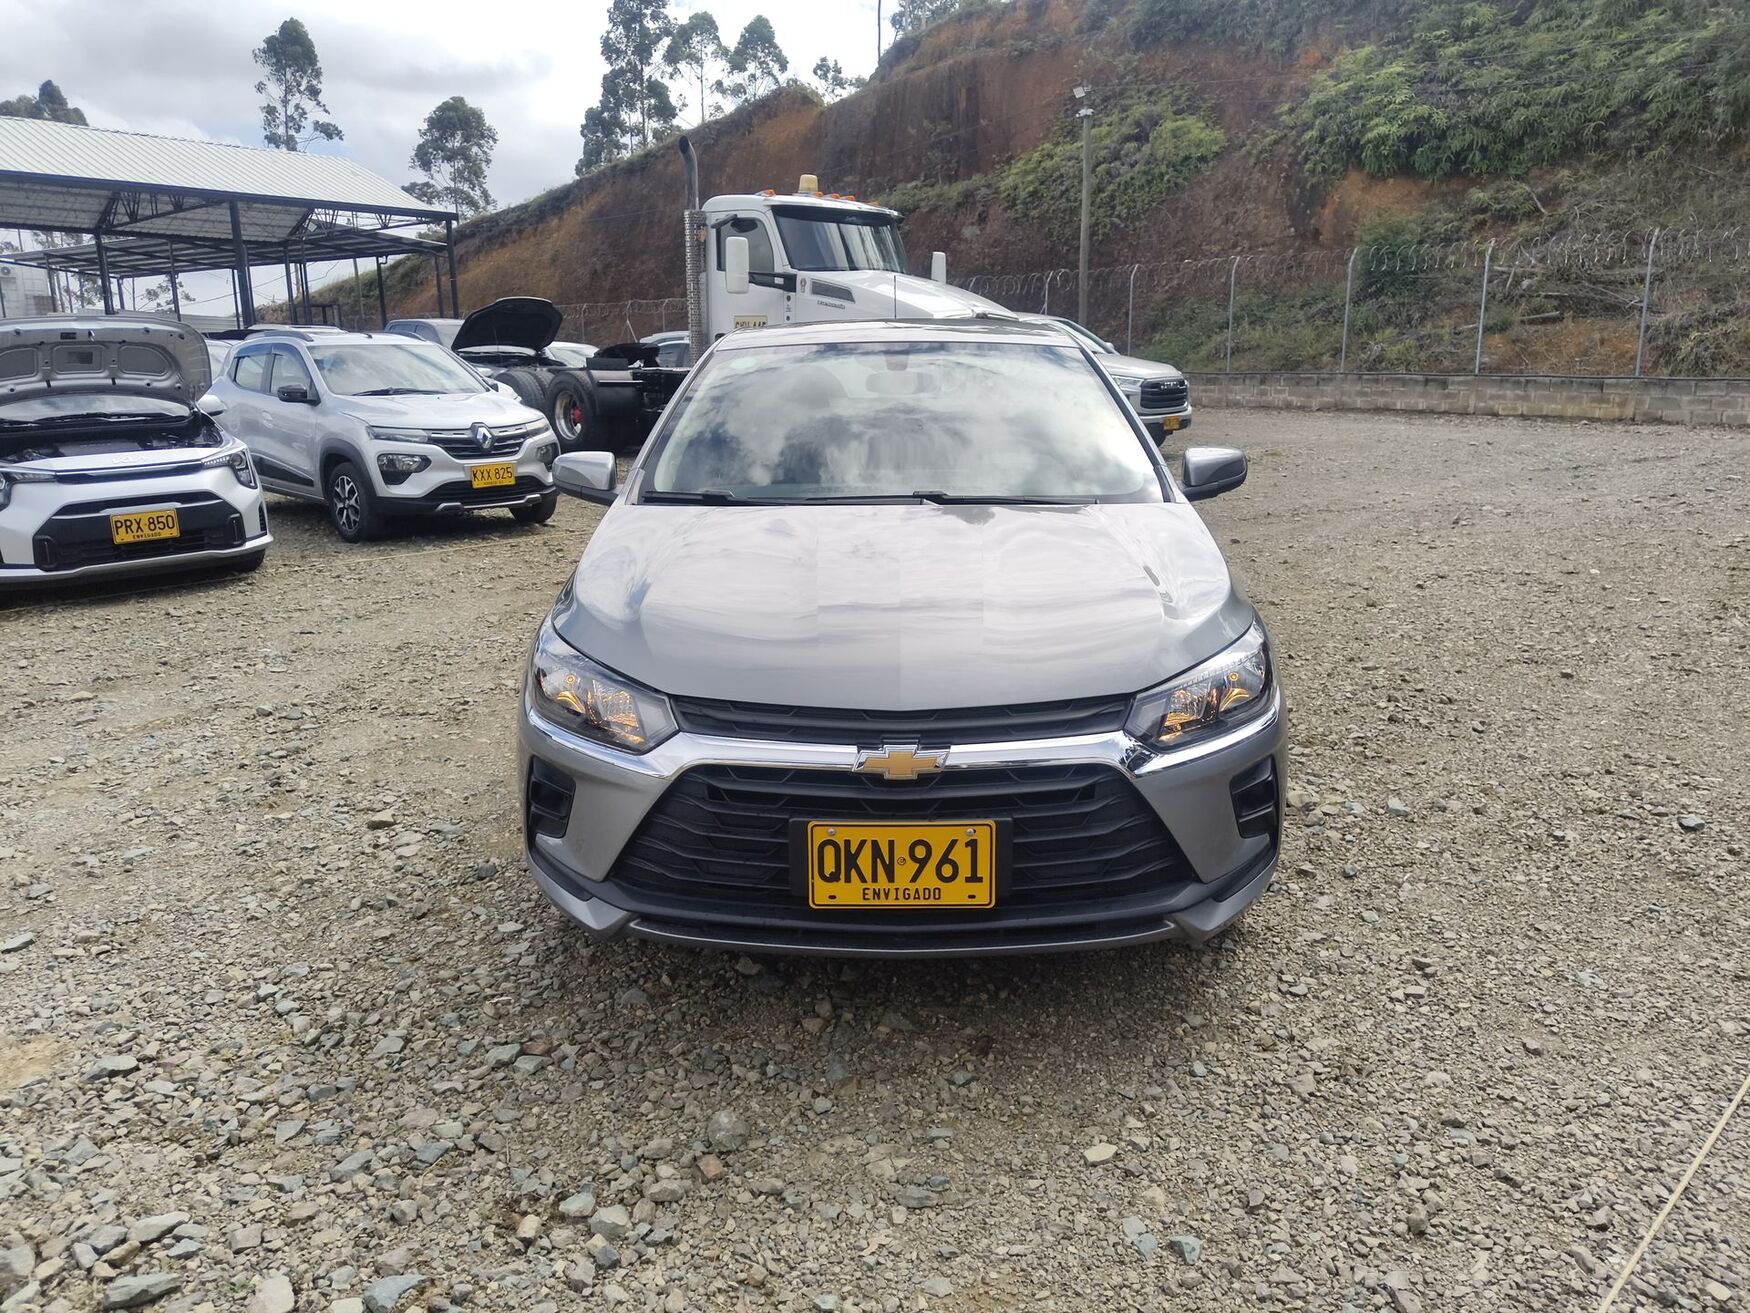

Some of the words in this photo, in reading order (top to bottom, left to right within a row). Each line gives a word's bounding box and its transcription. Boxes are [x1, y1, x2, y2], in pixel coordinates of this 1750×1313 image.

[472, 468, 492, 481] KXX
[494, 466, 513, 480] 825
[114, 517, 144, 535] PRX
[147, 514, 175, 531] 850
[817, 839, 895, 883] QKN
[908, 839, 983, 883] 961
[862, 887, 941, 901] ENVIGADO
